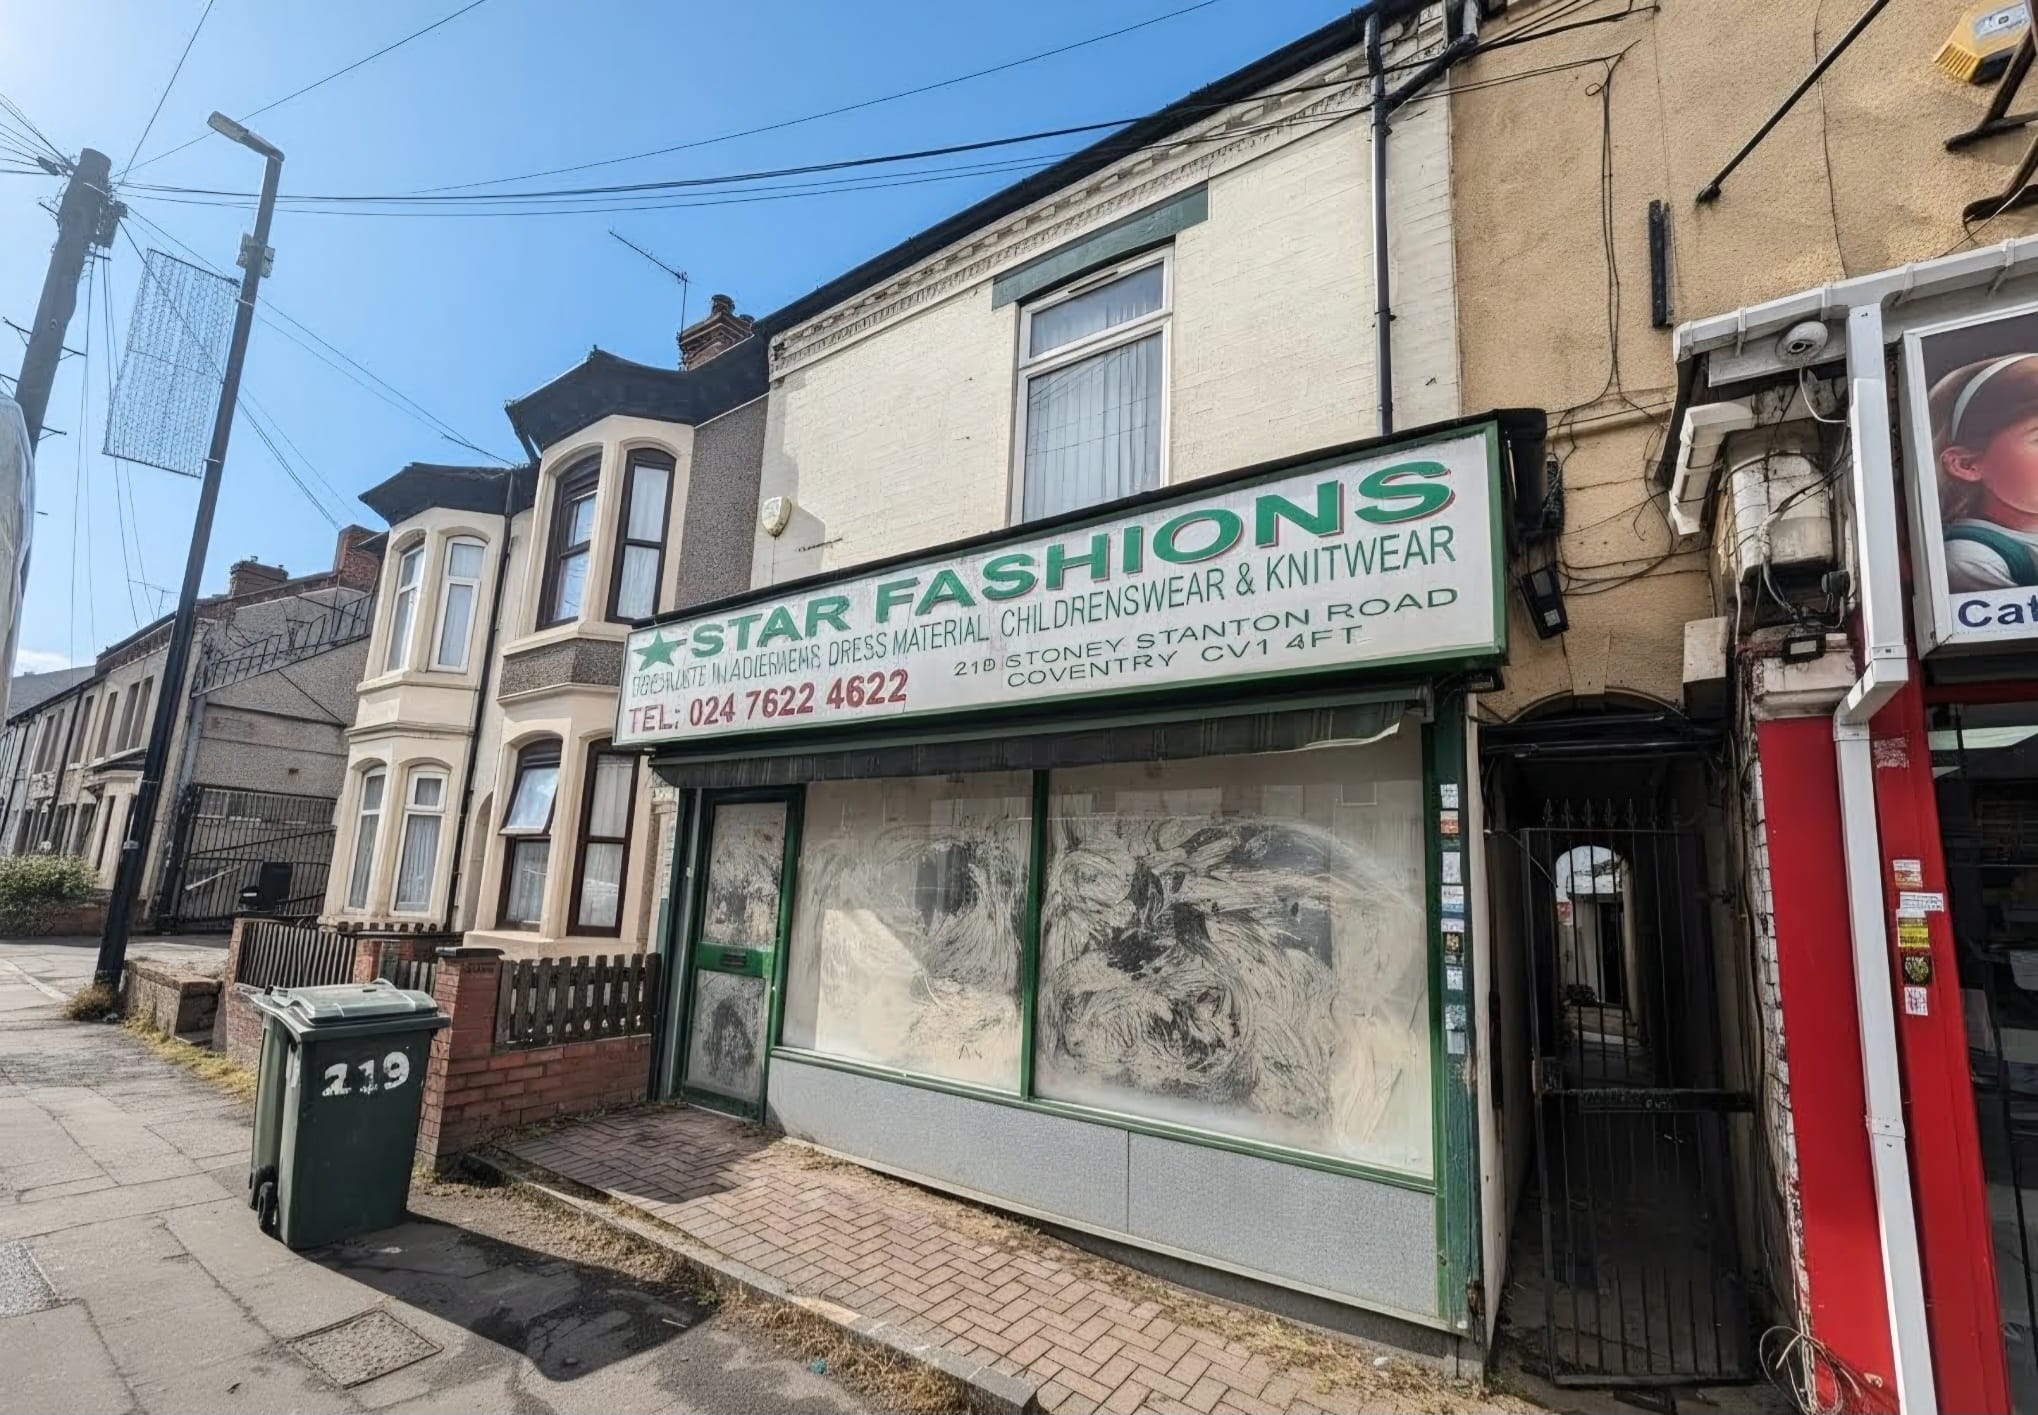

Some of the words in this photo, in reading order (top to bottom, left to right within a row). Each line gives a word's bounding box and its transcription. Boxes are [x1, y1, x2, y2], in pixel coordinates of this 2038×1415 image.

[692, 595, 851, 658] STAR
[876, 461, 1455, 623] FASHIONS
[828, 631, 888, 665] DRESS
[892, 614, 990, 656] MATERIAL
[1001, 568, 1225, 637] CHILDRENSWEAR
[1236, 562, 1256, 596] &
[1266, 525, 1456, 592] KNITWEAR
[1006, 637, 1125, 668] STONEY
[1137, 608, 1310, 650] STANTON
[1327, 588, 1459, 622] ROAD
[1007, 650, 1178, 688] COVENTRY
[1201, 639, 1267, 662] CV1
[1286, 625, 1363, 650] 4FT
[689, 694, 736, 727] 024
[745, 681, 816, 719] 7622
[826, 669, 909, 709] 4622
[322, 1051, 411, 1097] 219
